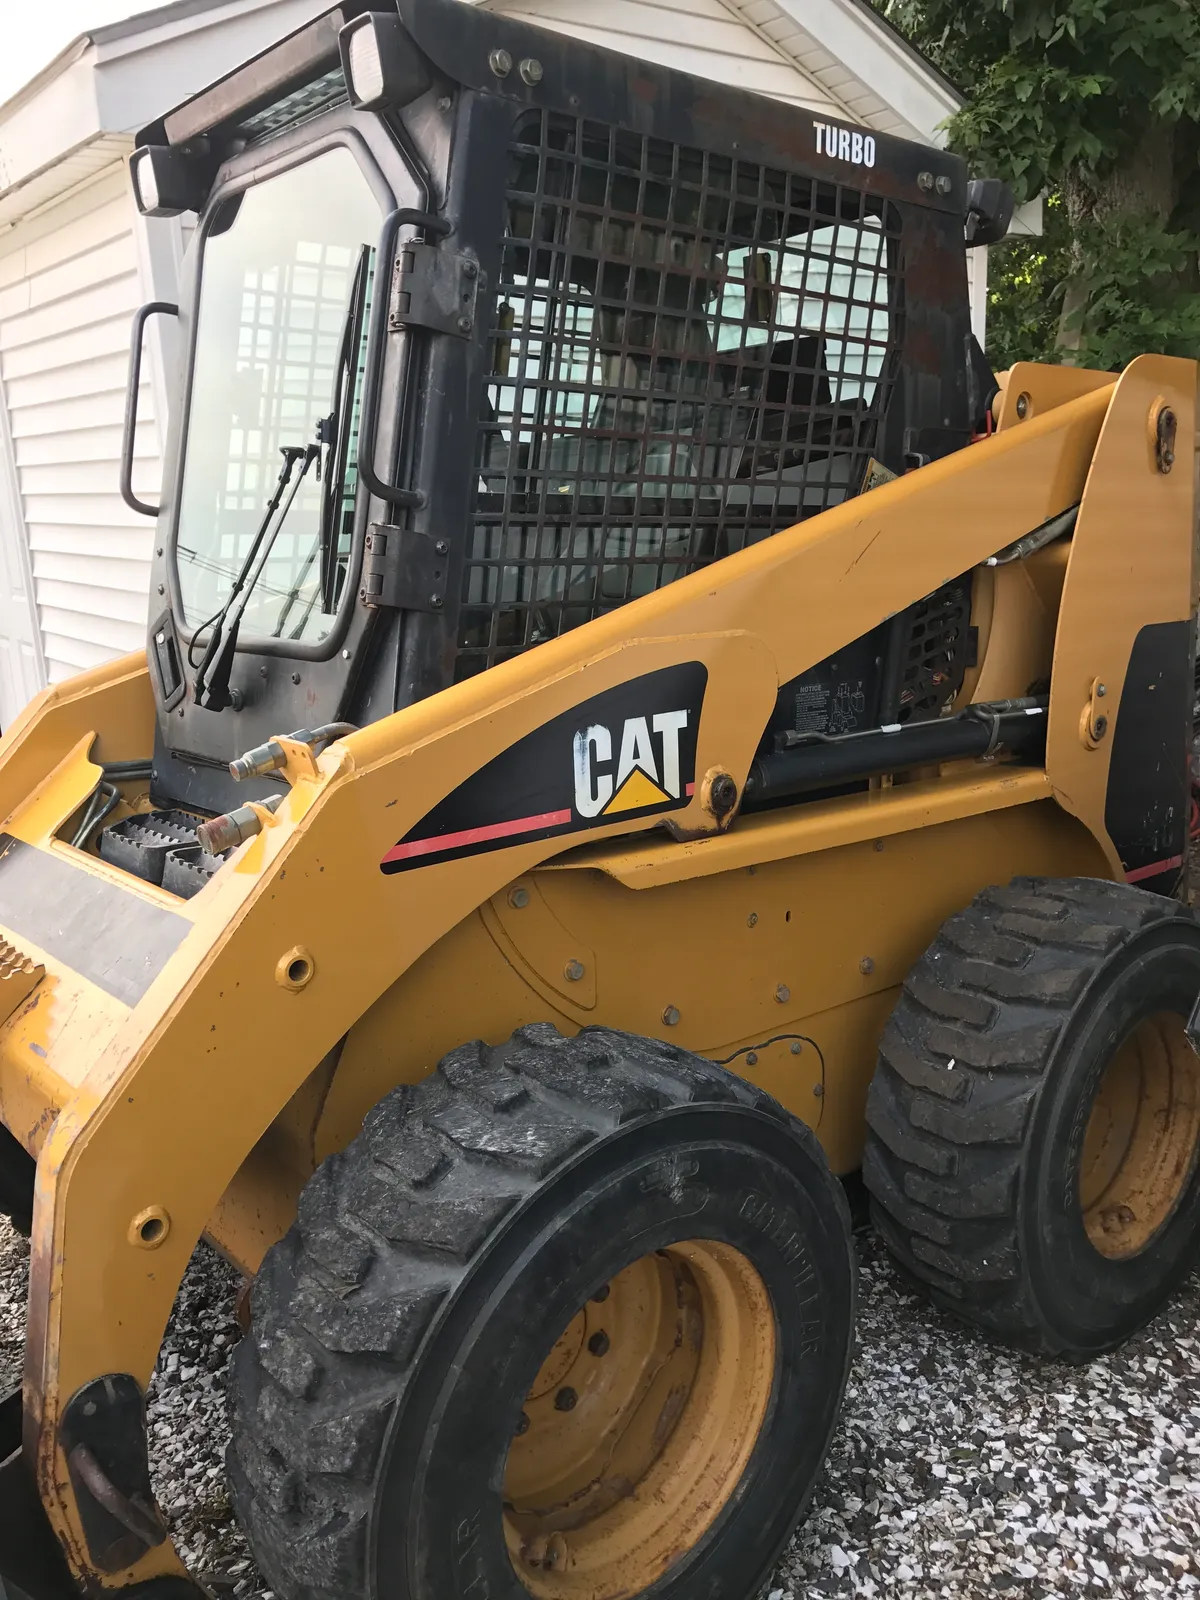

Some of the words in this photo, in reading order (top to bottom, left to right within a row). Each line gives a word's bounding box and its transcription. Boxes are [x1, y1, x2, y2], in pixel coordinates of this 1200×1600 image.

[812, 120, 876, 168] TURBO
[800, 685, 822, 693] NOTICE
[573, 709, 688, 818] CAT
